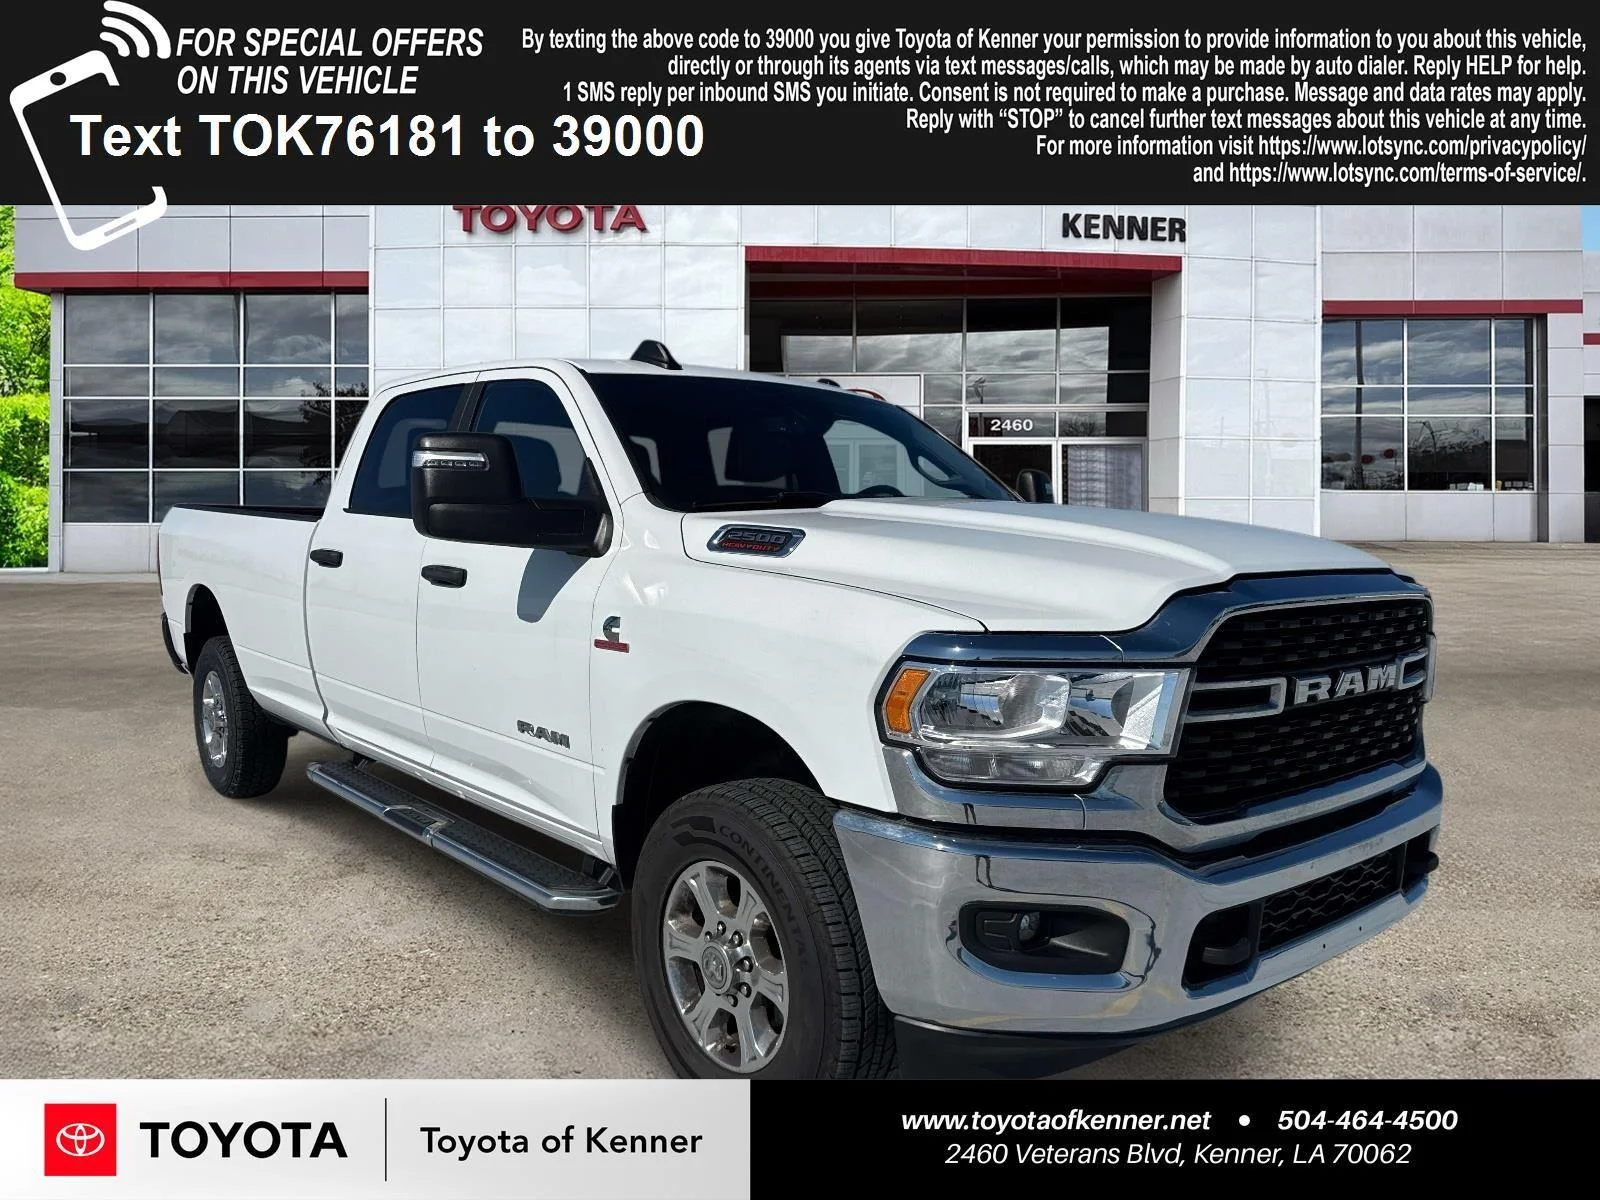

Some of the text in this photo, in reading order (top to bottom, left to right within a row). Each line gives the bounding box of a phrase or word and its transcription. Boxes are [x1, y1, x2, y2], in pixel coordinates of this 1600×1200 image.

[453, 205, 648, 233] TOYOTA
[1062, 213, 1187, 242] KENNER
[990, 418, 1034, 432] 2460
[728, 530, 786, 544] 2500
[1294, 664, 1397, 705] RAM
[517, 719, 571, 749] RAM
[717, 825, 810, 968] CONTINENTAL
